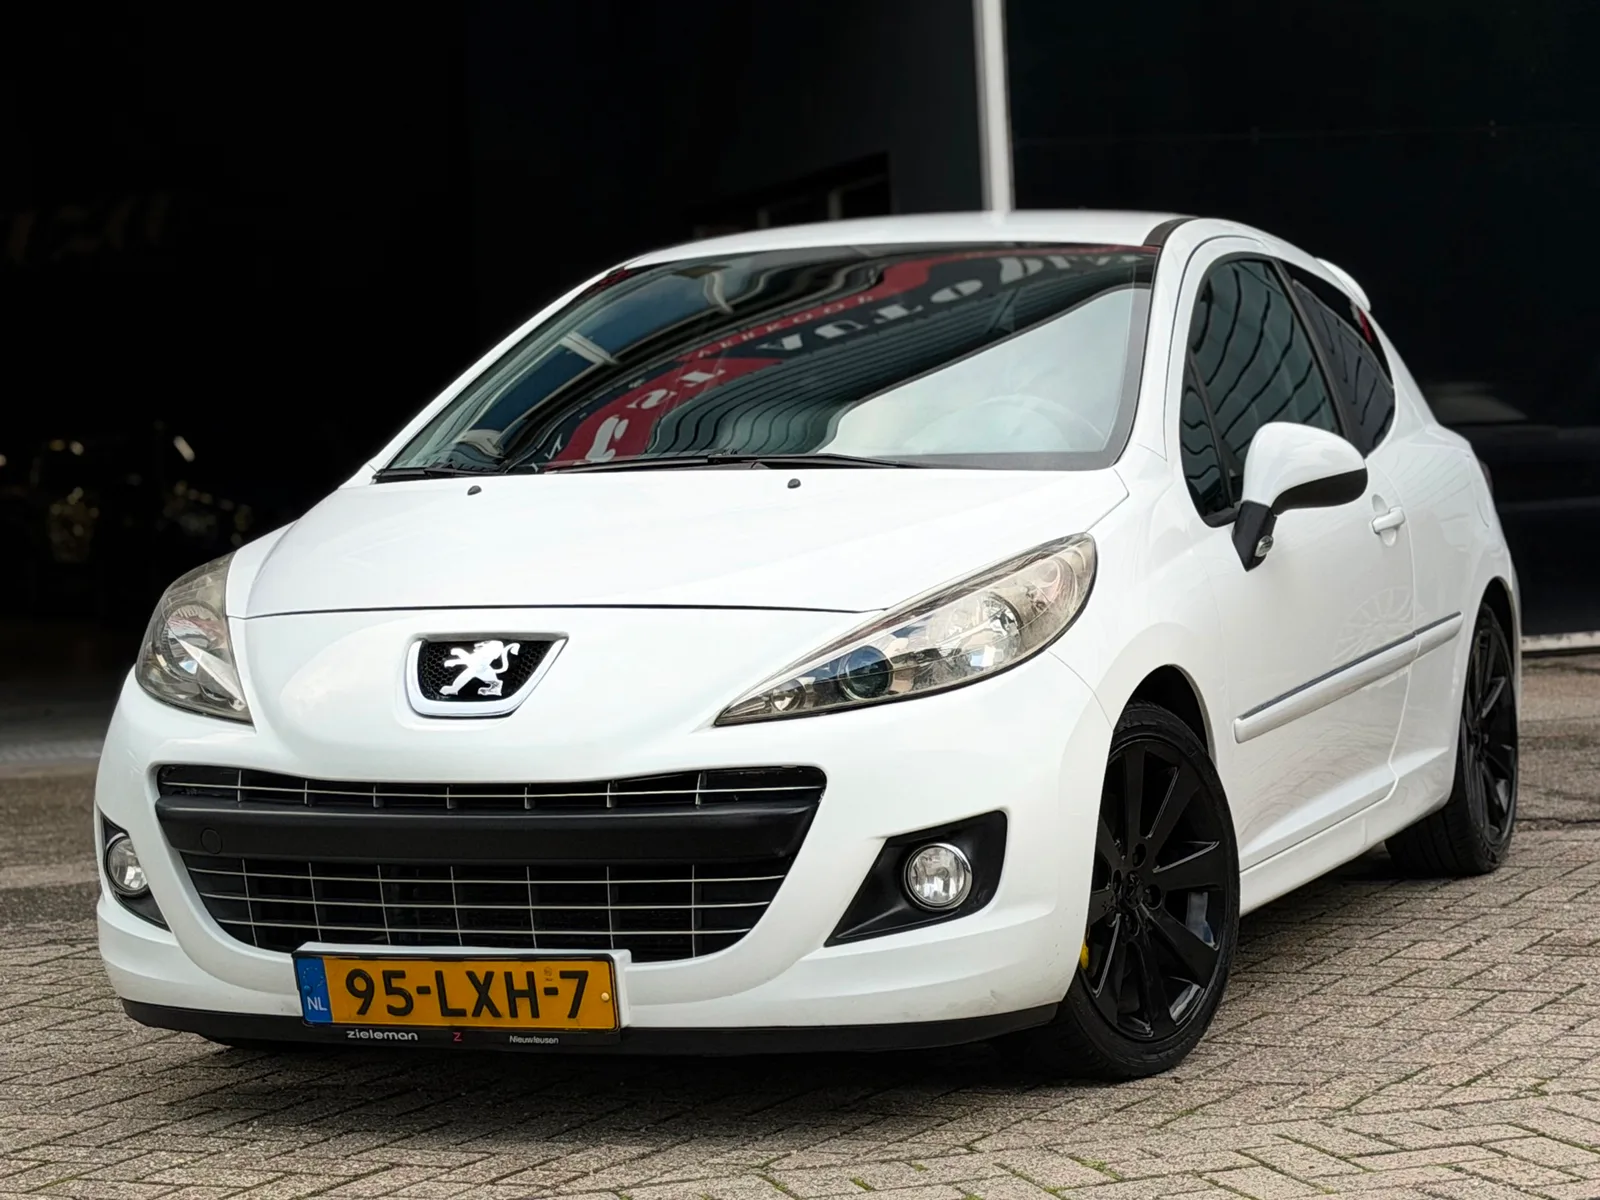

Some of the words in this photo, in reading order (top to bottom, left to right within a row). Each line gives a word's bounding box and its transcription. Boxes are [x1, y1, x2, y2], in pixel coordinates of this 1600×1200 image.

[345, 968, 589, 1019] 95-LXH-7
[306, 996, 328, 1012] NL
[346, 1029, 419, 1041] zieleman
[509, 1035, 559, 1045] Nieuwleusen
